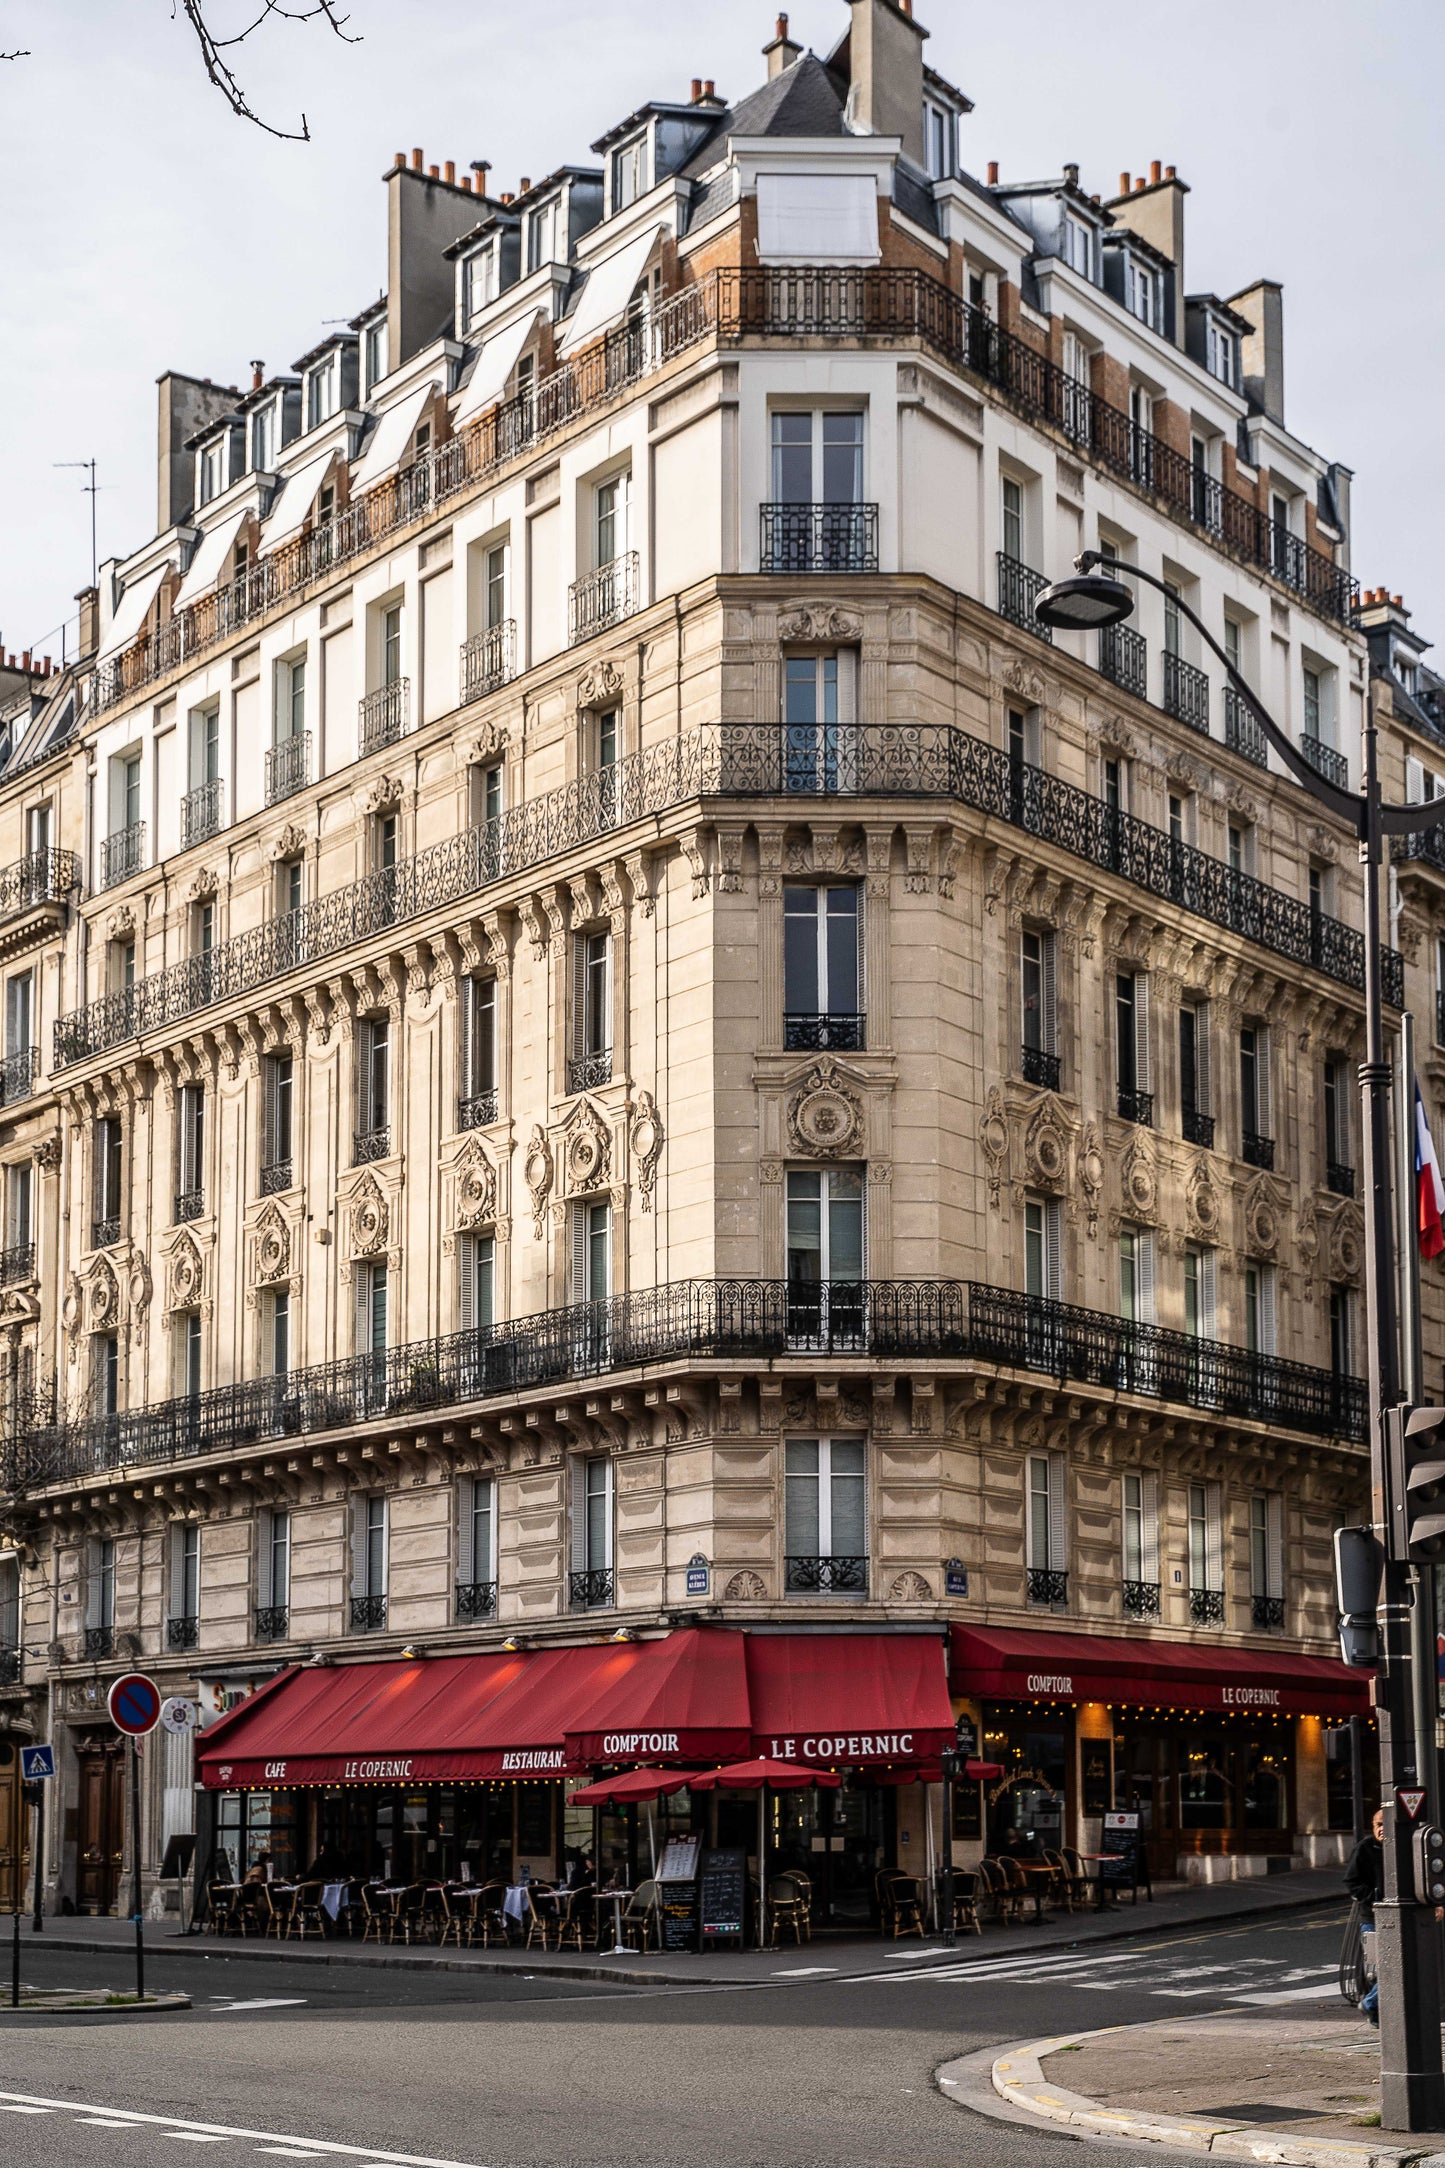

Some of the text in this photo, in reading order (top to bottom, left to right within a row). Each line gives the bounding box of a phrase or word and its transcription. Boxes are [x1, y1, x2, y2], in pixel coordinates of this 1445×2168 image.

[688, 1581, 706, 1589] KLÉBER
[1027, 1674, 1073, 1694] COMPTOIR
[1222, 1687, 1280, 1706] LE COPERNIC
[603, 1733, 680, 1754] COMPTOIR
[771, 1734, 914, 1759] LE COPERNIC
[344, 1759, 413, 1778] LE COPERNIC
[501, 1750, 567, 1770] RESTAURAN
[264, 1762, 287, 1778] CAFE
